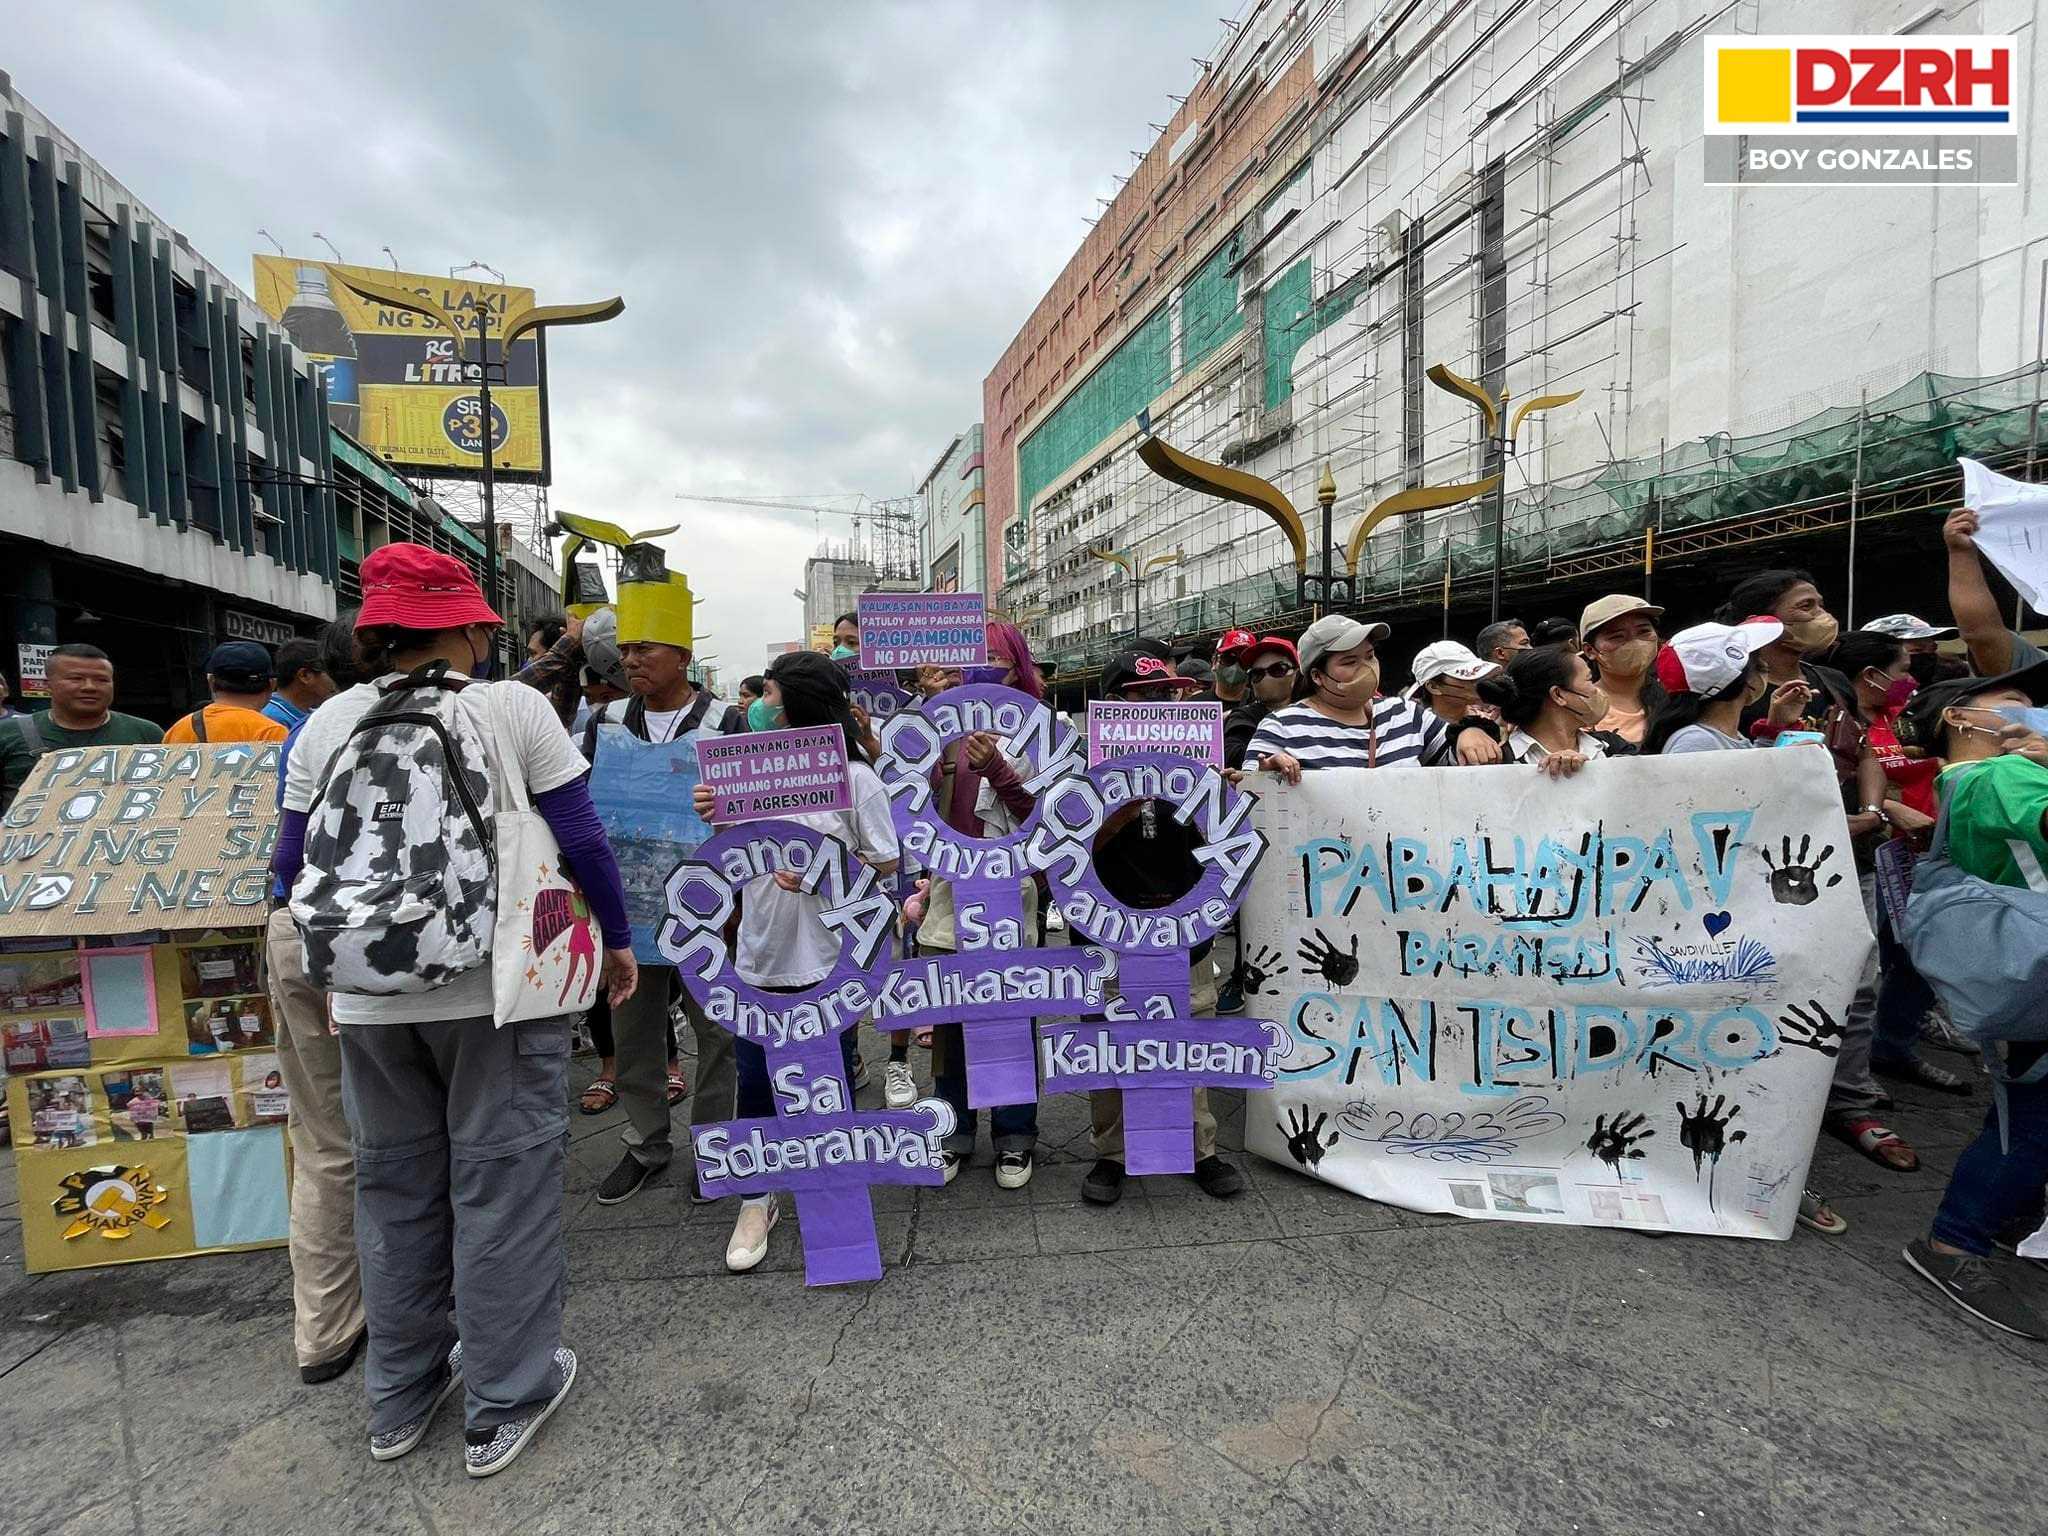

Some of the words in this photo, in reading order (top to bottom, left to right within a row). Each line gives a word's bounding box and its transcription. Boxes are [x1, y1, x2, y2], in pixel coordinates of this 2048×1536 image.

[378, 310, 413, 328] NG
[421, 313, 502, 332] SRAP!
[425, 340, 453, 360] RC
[456, 400, 494, 415] SR
[461, 438, 484, 448] LAN
[862, 601, 921, 612] KALIKASAN
[927, 601, 940, 611] NG
[944, 600, 983, 611] BAYAN
[861, 616, 904, 627] PATULOY
[908, 617, 928, 626] ANG
[930, 615, 984, 626] PAGKASIRA
[864, 628, 984, 648] PAGDAMBONG
[875, 650, 894, 664] NG
[900, 648, 976, 664] DAYUHAN!
[1094, 707, 1218, 721] REPRODUKTIBONG
[1100, 724, 1213, 741] KALUSUGAN
[706, 740, 790, 759] SOBERANYANG
[795, 735, 835, 748] BAYAN
[41, 747, 283, 790] PABAHA
[705, 761, 742, 780] IGIIT
[751, 753, 811, 775] LABAN
[818, 751, 842, 768] SA
[710, 780, 771, 797] DAYUHANG
[774, 772, 845, 790] PAKIKIALAM
[3, 783, 279, 829] GOBYE
[727, 800, 746, 815] AT
[753, 790, 835, 812] AGRESYON!
[903, 820, 1030, 880] anyar
[960, 902, 1022, 952] Sa
[1400, 928, 1618, 986] BARANGAY
[872, 945, 1119, 1019] Kalikasan?
[1041, 1020, 1294, 1081] Kalusugan?
[1279, 990, 1437, 1087] SAN
[1457, 996, 1778, 1096] ISIDRO
[773, 1063, 847, 1117] Sa
[1378, 1110, 1507, 1142] 2023
[694, 1097, 957, 1183] Soberanya?
[78, 1172, 154, 1230] MAKABAYAN
